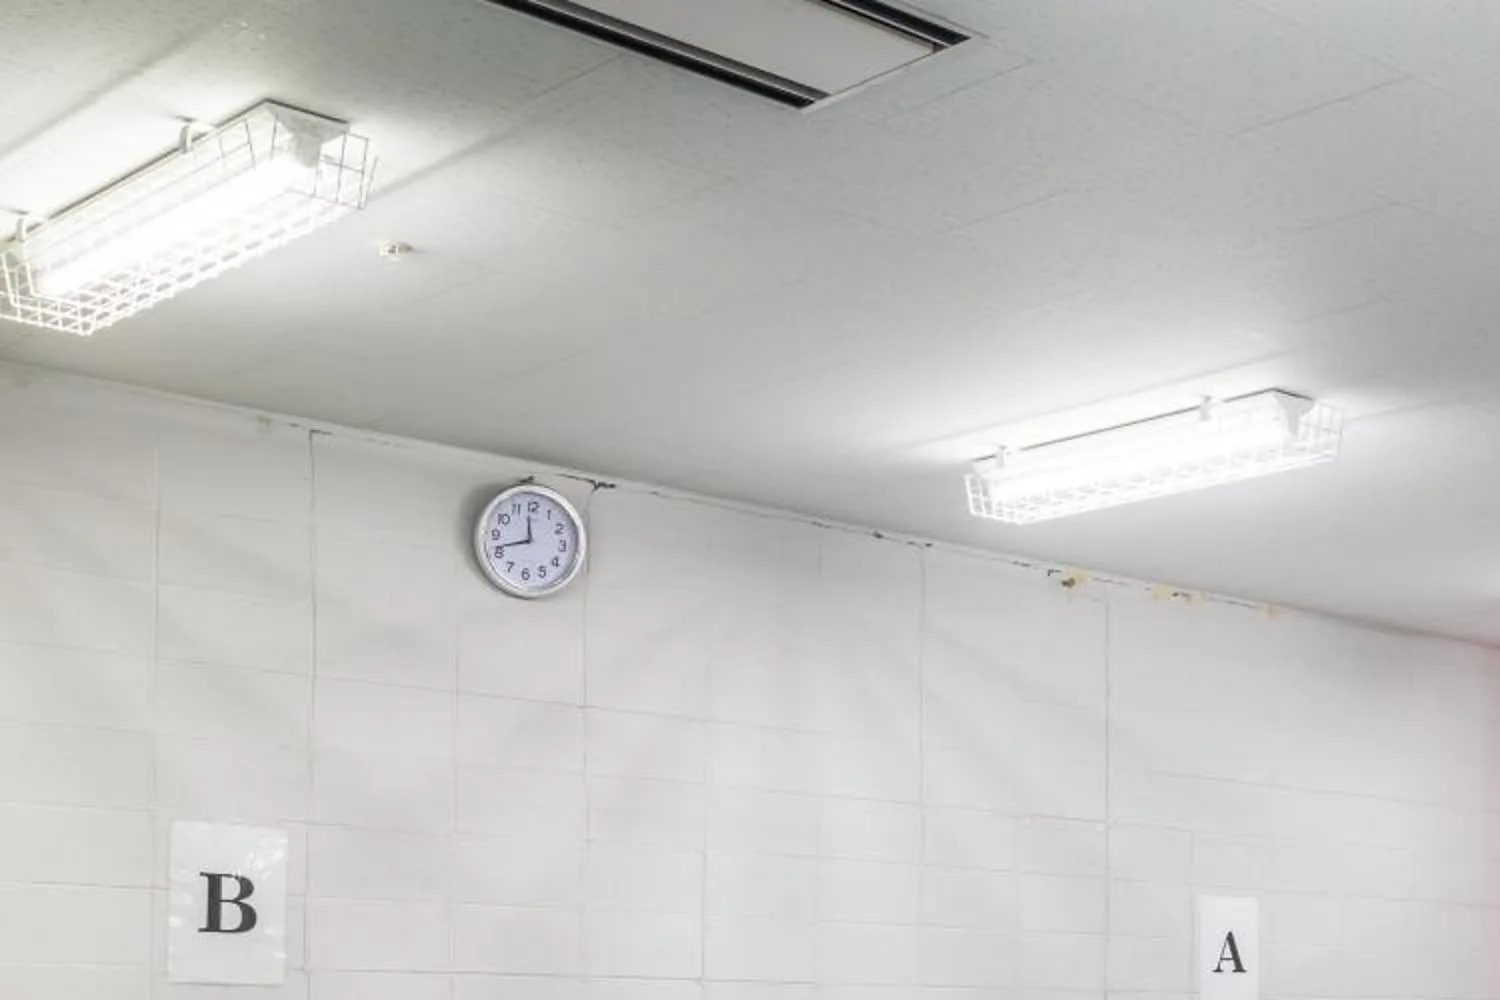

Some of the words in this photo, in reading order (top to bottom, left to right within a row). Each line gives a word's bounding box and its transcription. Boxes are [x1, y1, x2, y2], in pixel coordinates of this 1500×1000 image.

[511, 503, 521, 515] 11
[528, 501, 540, 513] 12
[497, 513, 511, 525] 10
[491, 528, 500, 541] 9
[554, 523, 565, 535] 2
[494, 545, 505, 559] 8
[558, 540, 567, 552] 3
[506, 561, 515, 573] 7
[551, 556, 560, 568] 4
[521, 568, 531, 581] 6
[537, 566, 547, 578] 5
[198, 871, 258, 933] B
[1212, 931, 1248, 973] A
